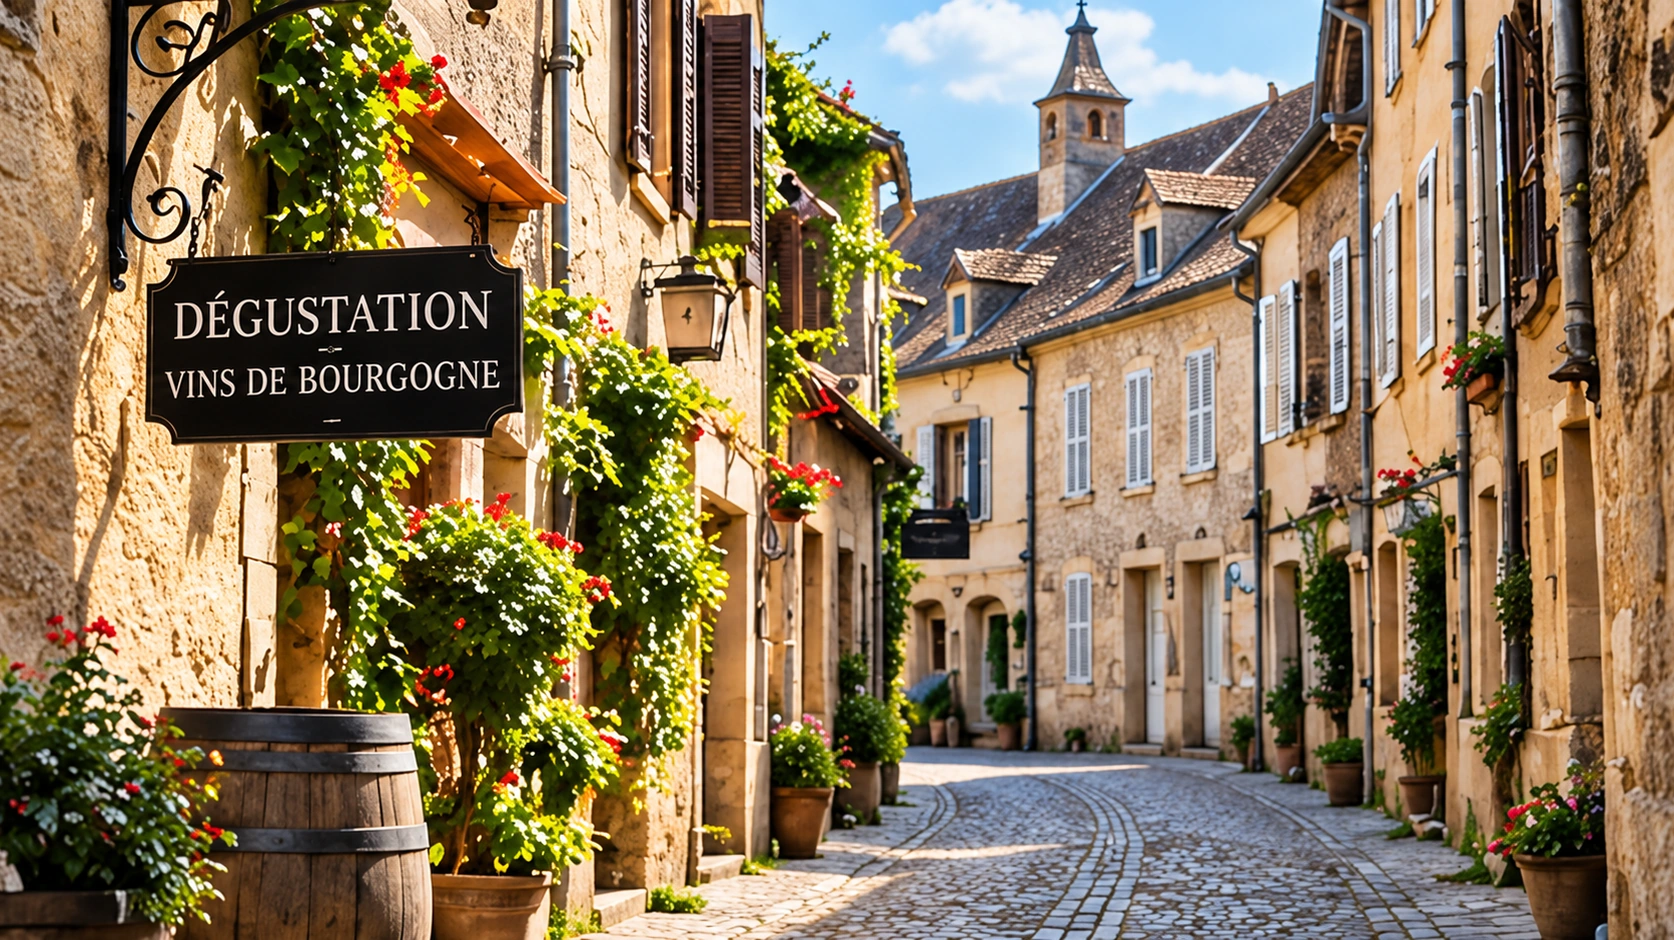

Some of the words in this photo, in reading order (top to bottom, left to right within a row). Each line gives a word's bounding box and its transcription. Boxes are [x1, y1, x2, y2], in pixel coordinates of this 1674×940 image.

[173, 289, 493, 340] DÉGUSTATION
[165, 369, 236, 399] VINS
[247, 367, 287, 396] DE
[299, 360, 501, 395] BOURGOGNE
